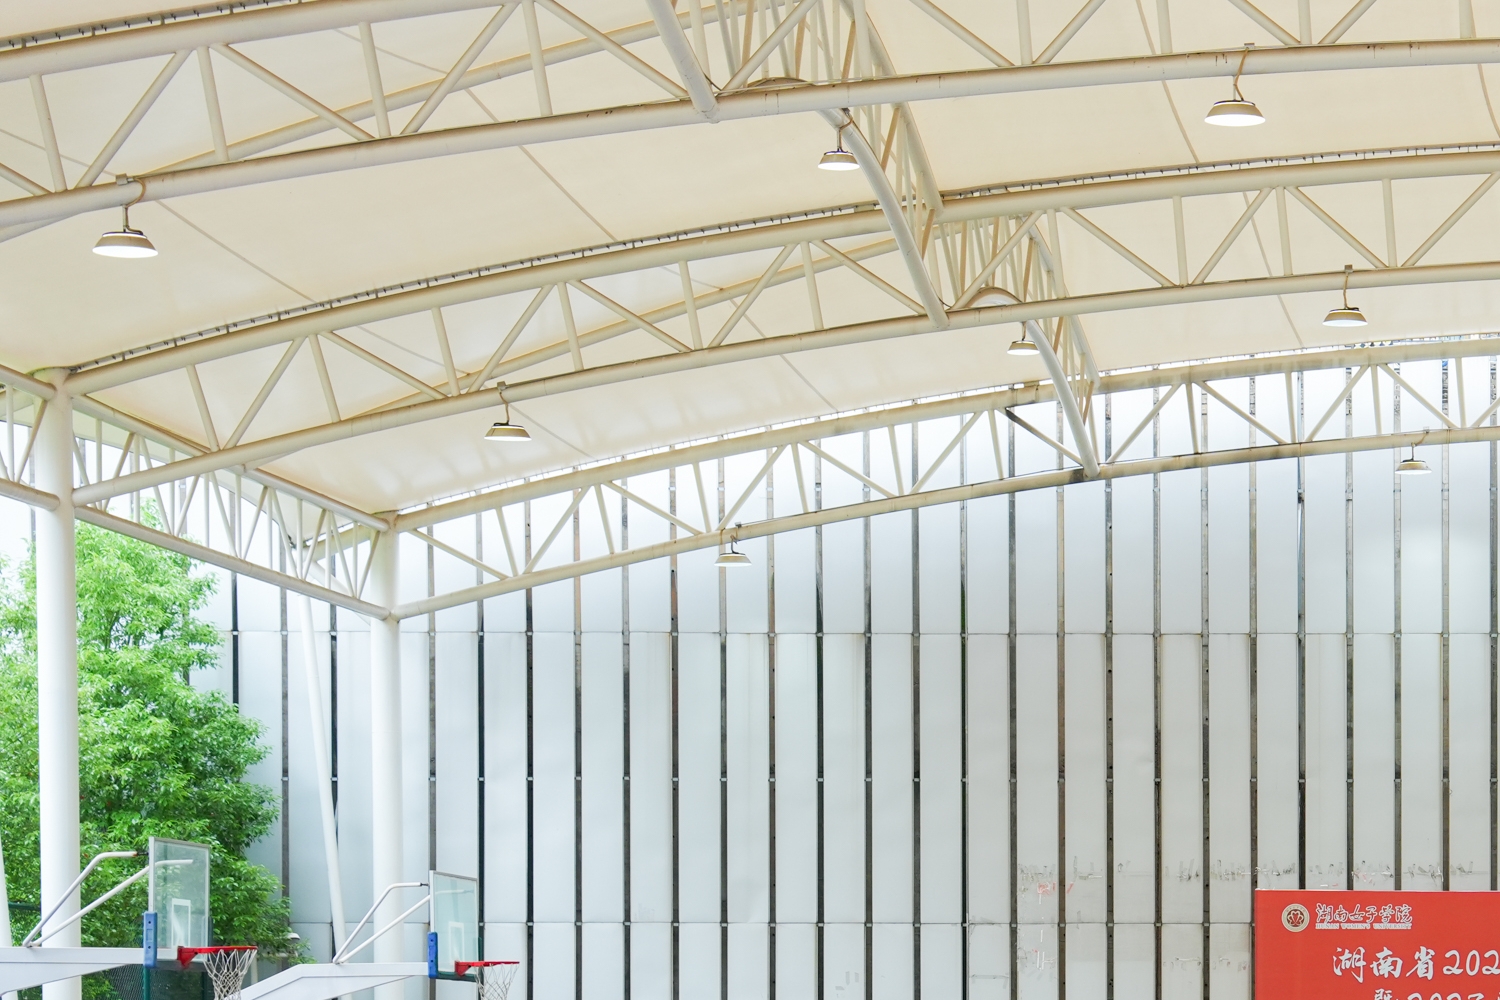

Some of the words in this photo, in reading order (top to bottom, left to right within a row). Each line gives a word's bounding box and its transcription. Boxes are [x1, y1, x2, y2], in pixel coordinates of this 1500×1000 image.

[1315, 902, 1413, 923] 湖南女子学院
